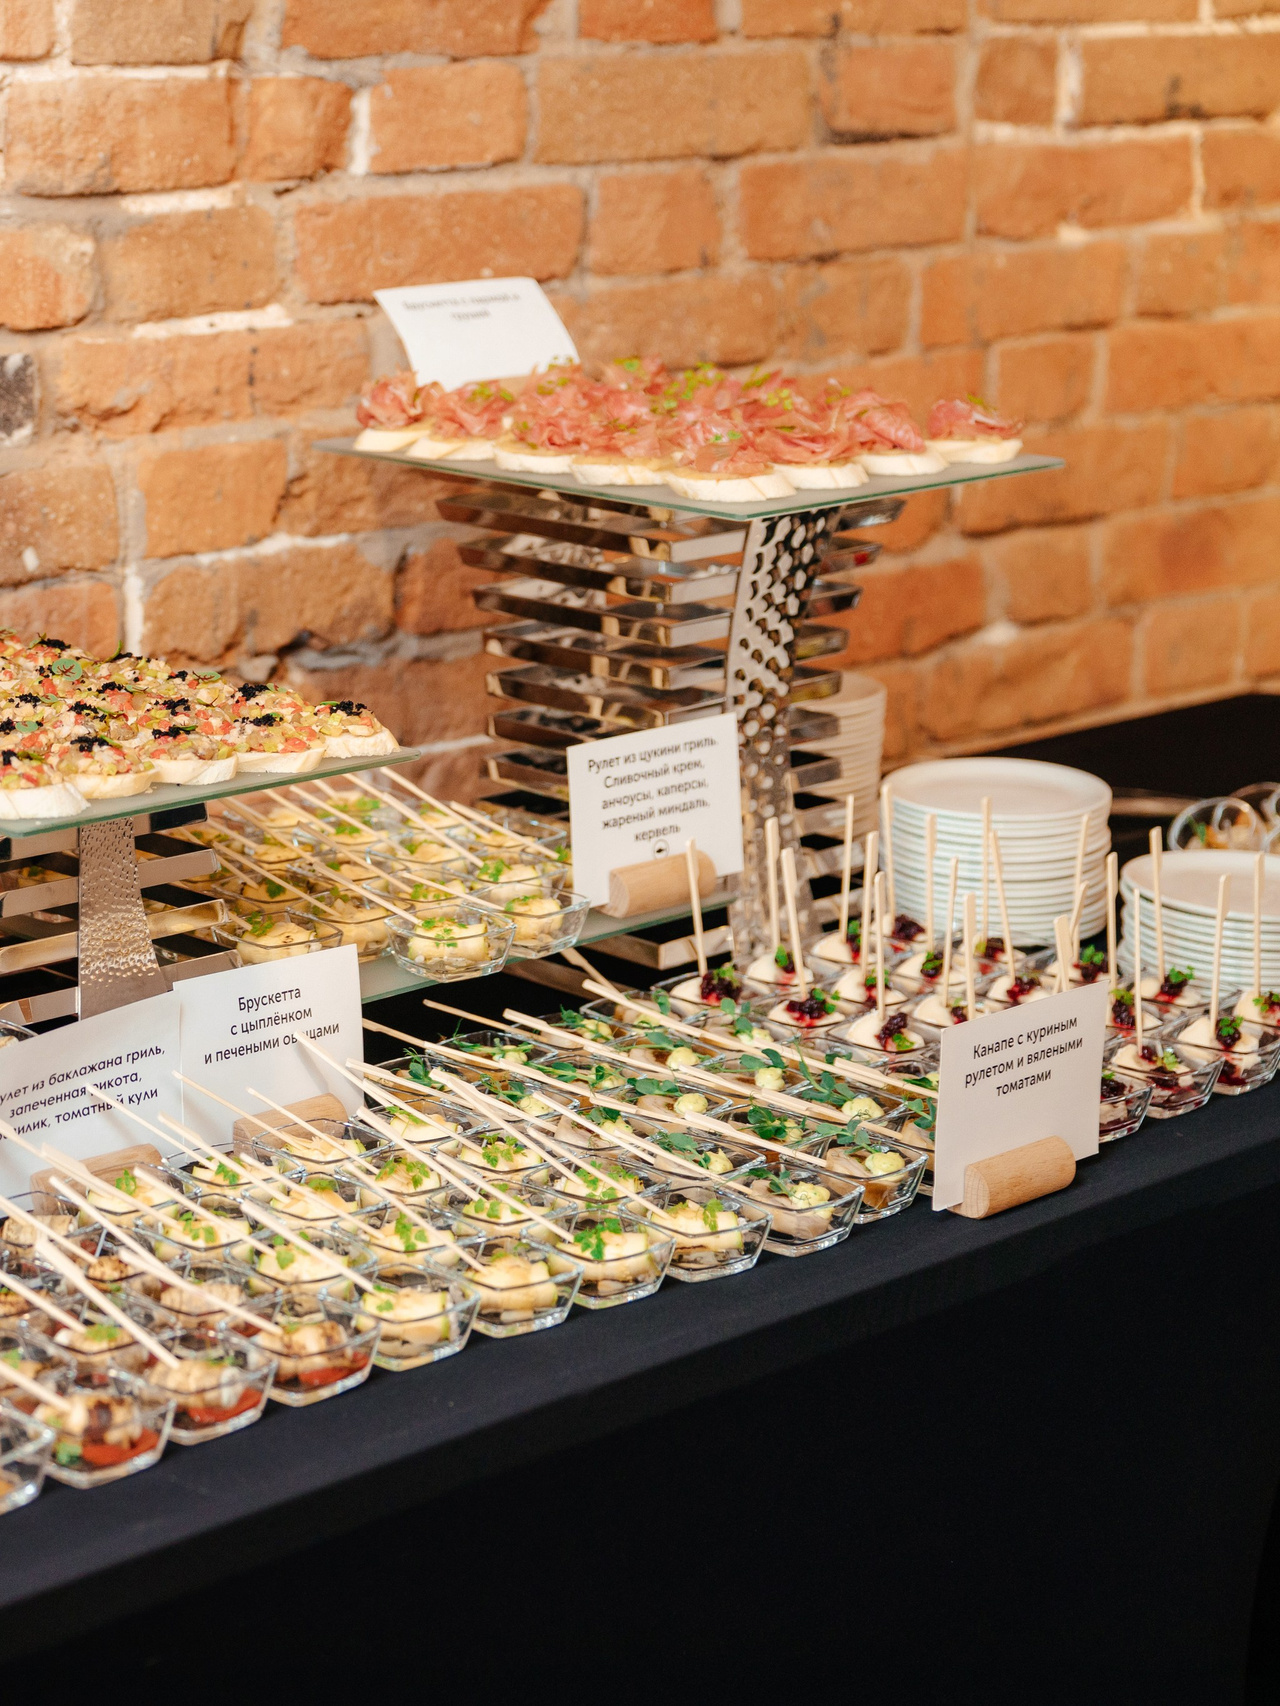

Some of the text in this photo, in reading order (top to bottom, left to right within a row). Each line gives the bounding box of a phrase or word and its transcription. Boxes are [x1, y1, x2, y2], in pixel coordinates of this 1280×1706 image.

[588, 756, 620, 774] Рулет
[623, 753, 637, 764] из
[639, 743, 681, 763] цукини
[604, 762, 670, 789] Сливочный
[601, 779, 709, 810] анчоусы, каперсы,
[602, 806, 655, 829] жареный
[634, 824, 681, 842] кервель
[238, 987, 301, 1013] Брускетта
[230, 1007, 312, 1036] с цыплёнком
[204, 1022, 340, 1065] и печеными овщами
[973, 1017, 1078, 1060] Канапе с куриным
[31, 1080, 45, 1092] из
[48, 1055, 123, 1086] баклажана
[126, 1045, 166, 1065] гриль,
[965, 1037, 1083, 1089] рулетом и вялеными
[128, 1087, 159, 1106] кули
[995, 1069, 1052, 1097] томатами
[9, 1086, 87, 1119] запеченная
